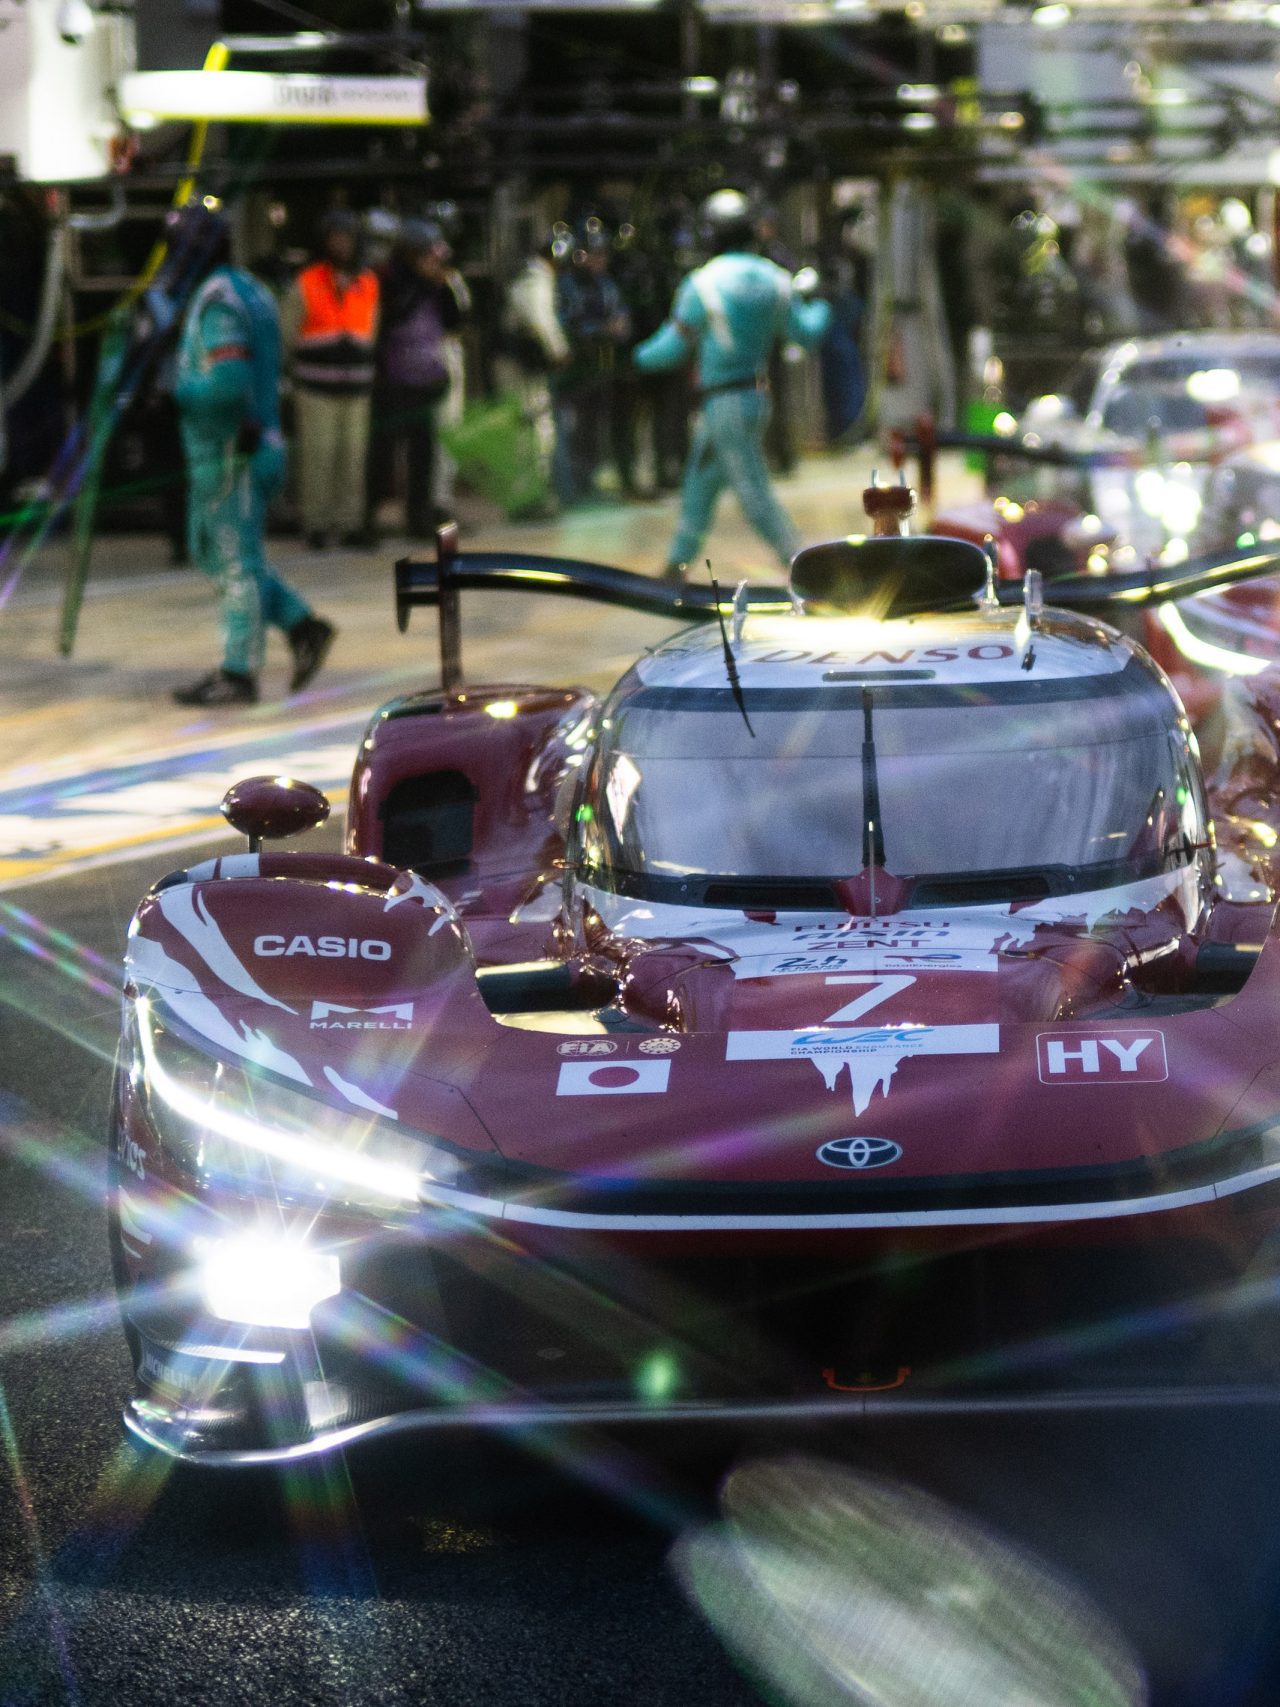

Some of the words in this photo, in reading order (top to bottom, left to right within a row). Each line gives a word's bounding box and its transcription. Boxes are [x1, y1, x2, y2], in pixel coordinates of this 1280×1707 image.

[753, 645, 1013, 665] DENSO
[795, 921, 950, 932] FUJITSU
[254, 935, 392, 961] CASIO
[807, 940, 932, 951] ZENT
[823, 975, 917, 1022] 7
[792, 1029, 935, 1045] WEC
[560, 1042, 611, 1054] FIA
[1047, 1039, 1154, 1073] HY
